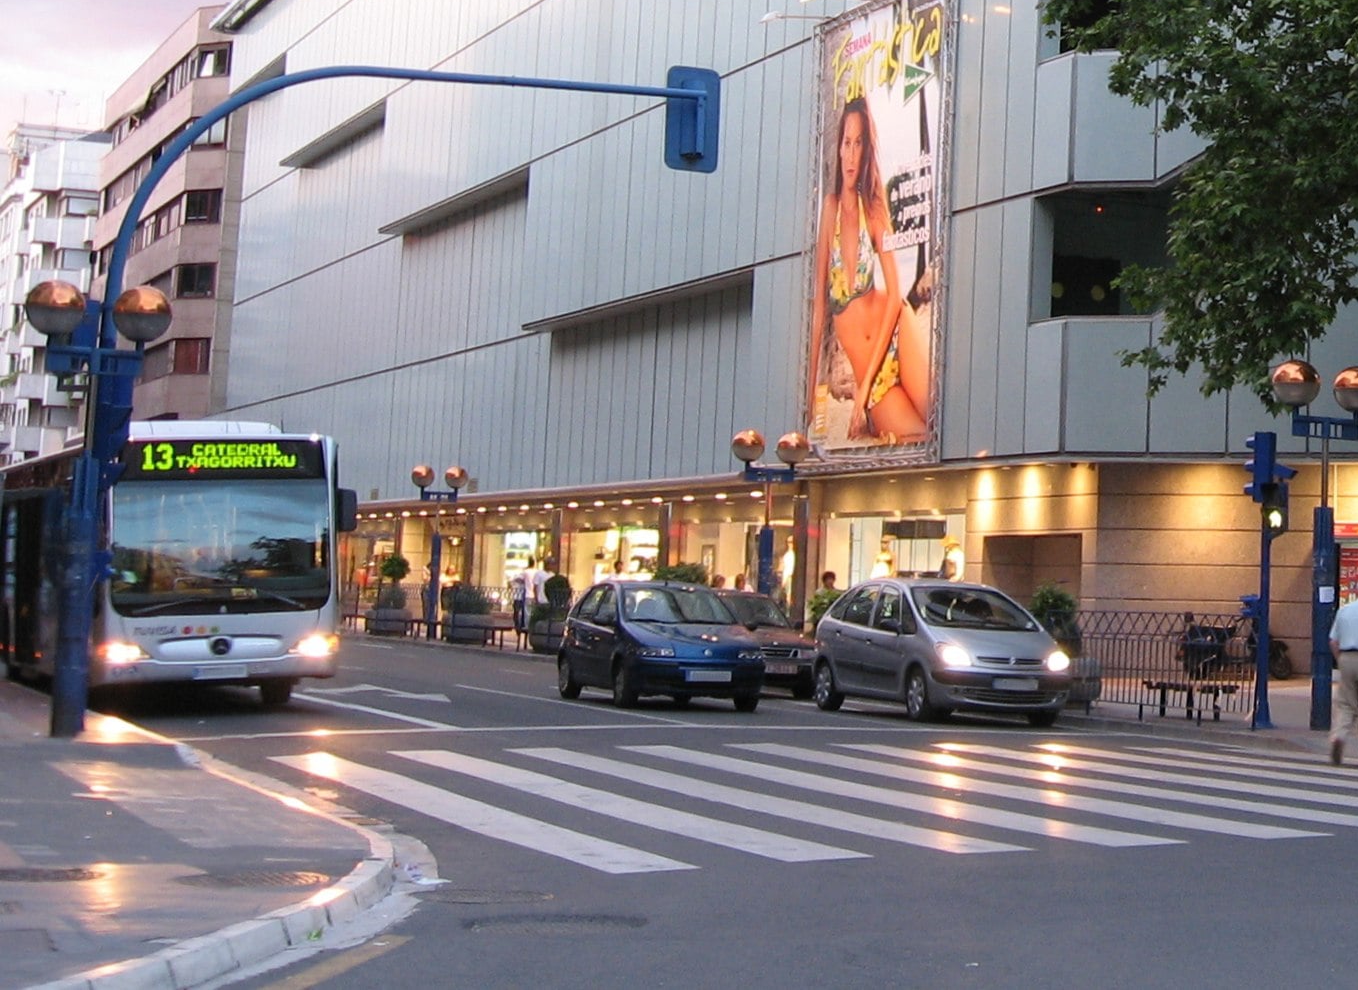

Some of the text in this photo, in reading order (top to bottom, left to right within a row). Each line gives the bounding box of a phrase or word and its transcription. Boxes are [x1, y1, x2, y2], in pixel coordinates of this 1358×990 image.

[899, 175, 931, 200] verano
[142, 442, 174, 471] 13
[191, 442, 282, 457] CATEDRAL
[176, 454, 297, 469] TXAGORRITXU
